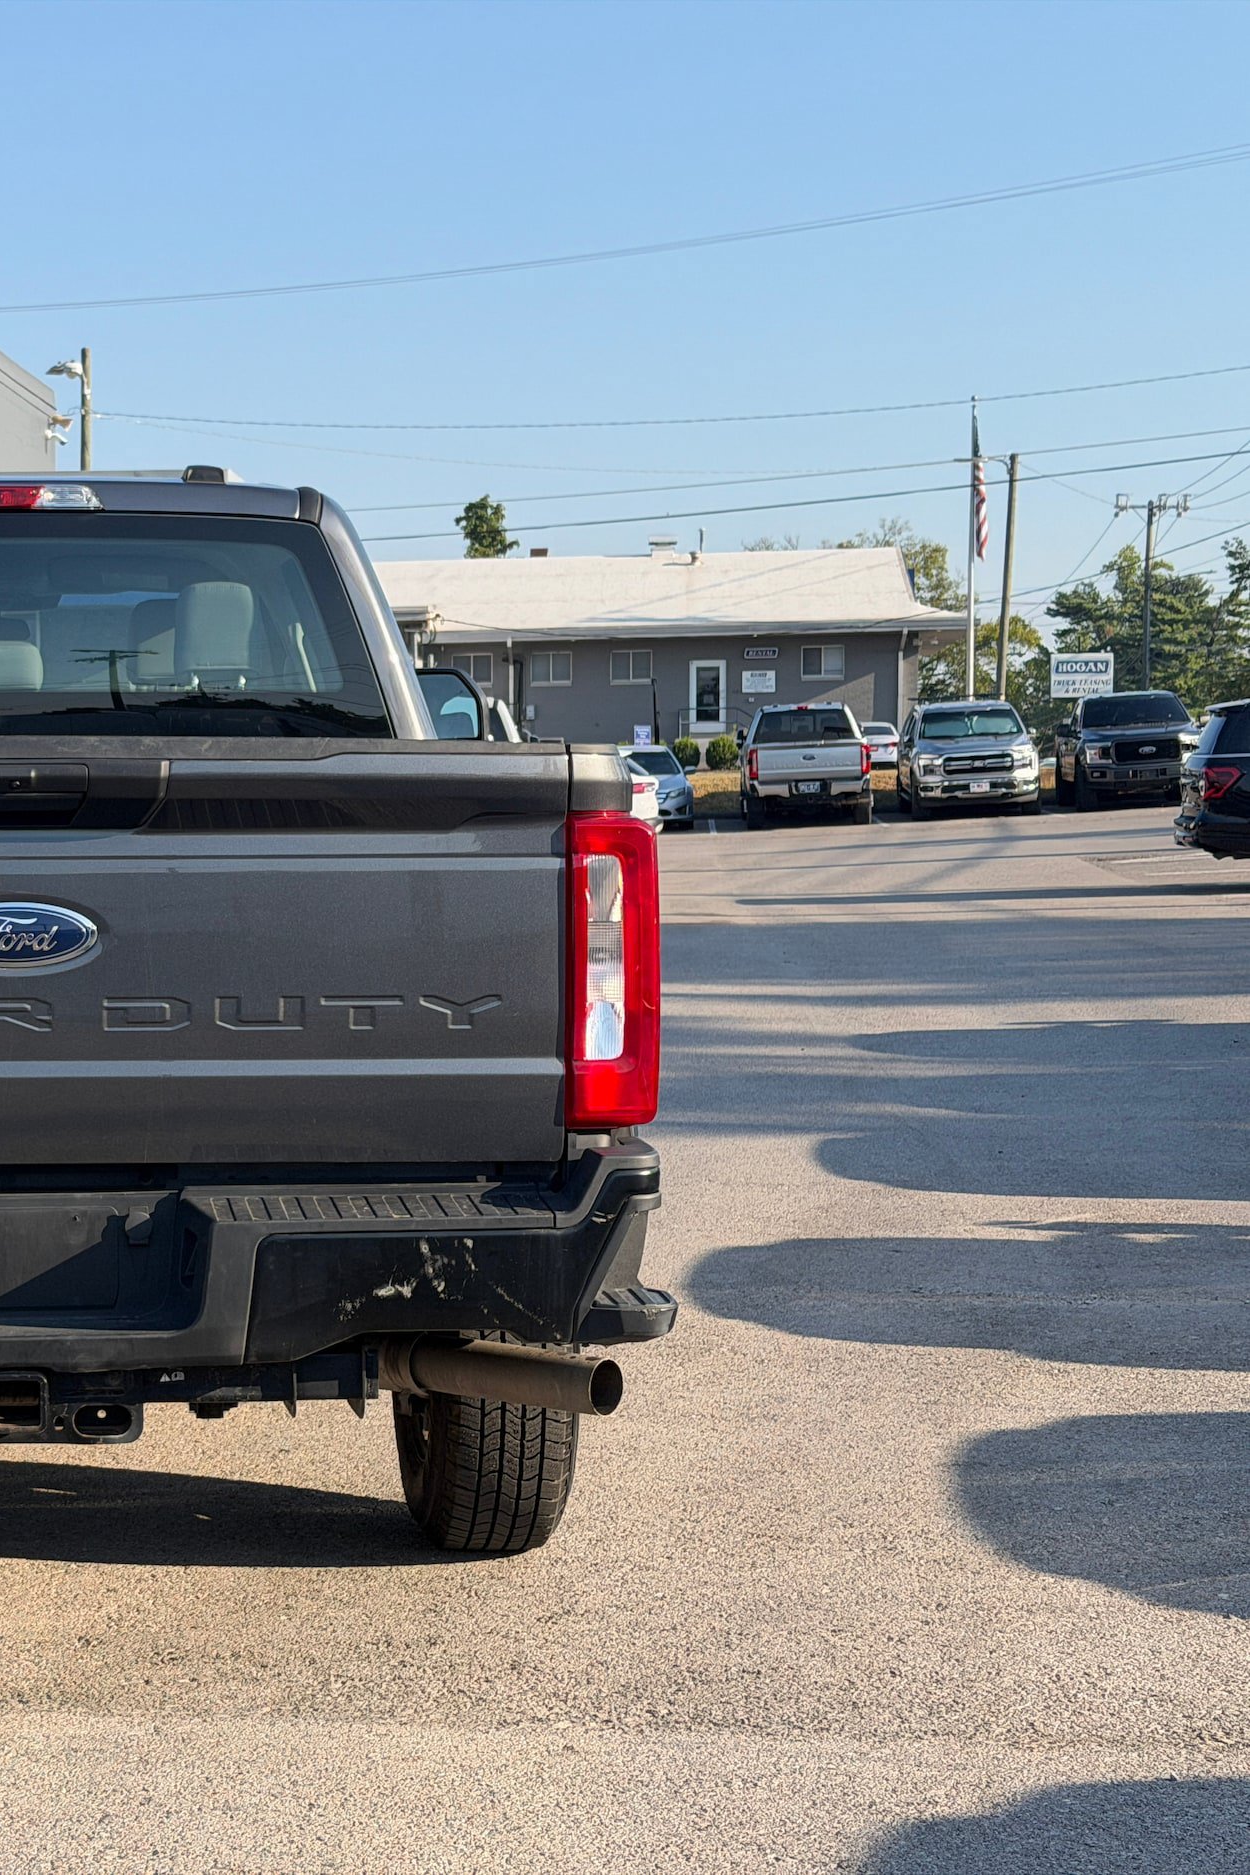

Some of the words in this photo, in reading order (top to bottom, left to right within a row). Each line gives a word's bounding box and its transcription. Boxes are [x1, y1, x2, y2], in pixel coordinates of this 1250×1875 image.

[1058, 661, 1107, 673] HOGAN
[1053, 679, 1076, 687] TRUCK
[1079, 679, 1111, 687] LEASING
[102, 993, 502, 1032] DUTY
